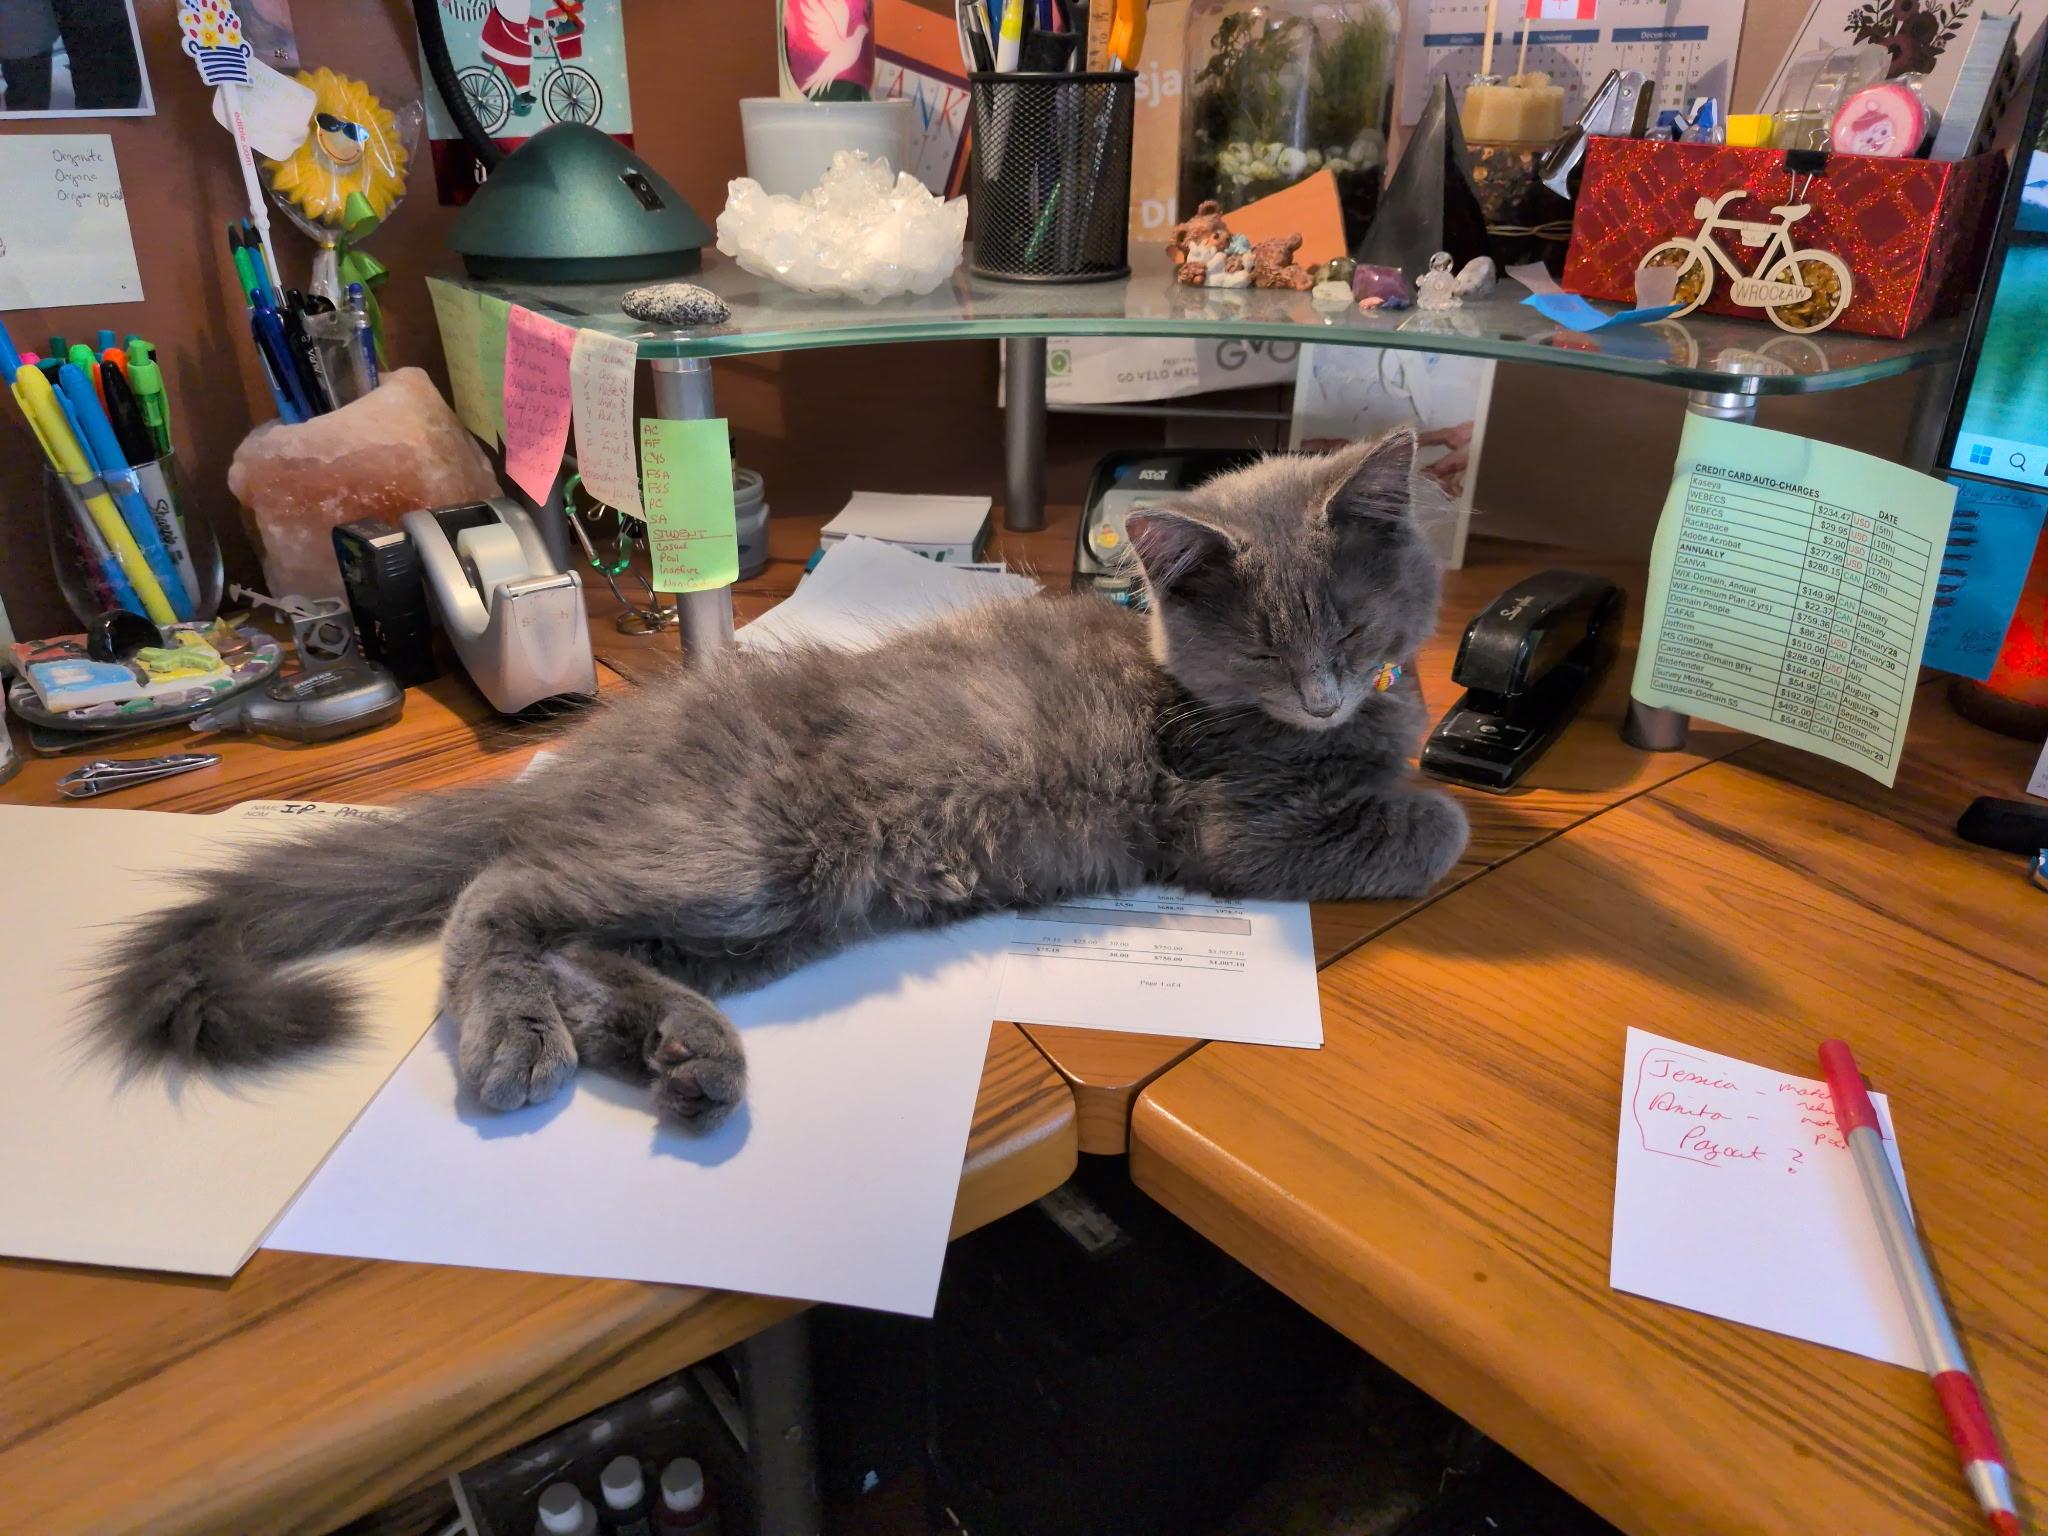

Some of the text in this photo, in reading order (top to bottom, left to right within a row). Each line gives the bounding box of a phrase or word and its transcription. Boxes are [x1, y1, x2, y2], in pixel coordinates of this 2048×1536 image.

[874, 64, 970, 139] ANK
[234, 111, 252, 166] edible.com
[1138, 469, 1169, 481] AT&T
[1695, 463, 1820, 498] CREDIT CARD AUTO-CHARGES
[1687, 503, 1893, 568] WEBECS $2.00 USD (12th)
[1689, 489, 1896, 554] WEBECS $29.95 USD (10th)
[1818, 505, 1851, 521] $234.47
[1853, 516, 1871, 529] USD
[1875, 523, 1894, 538] (5th)
[1878, 510, 1899, 525] DATE
[1680, 543, 1725, 559] ANNUALLY
[1682, 530, 1888, 596] Adobe Acrobat $280.15 CAN (26th)
[1684, 517, 1729, 532] Rackspace
[1845, 558, 1863, 570] USD
[1867, 566, 1891, 582] (17th)
[1677, 557, 1706, 568] CANVA
[1838, 598, 1856, 610] CAN
[1860, 606, 1889, 625] January
[1728, 581, 1757, 595] Annual
[1804, 600, 1833, 616] $22.37
[1835, 611, 1853, 624] CAN
[1858, 619, 1886, 638] January
[1728, 594, 1746, 605] Plan
[1833, 624, 1851, 637] CAN
[1669, 593, 1701, 607] Domain
[1703, 601, 1731, 615] People
[1830, 637, 1848, 649] USD
[1676, 633, 1714, 649] OneDrive
[1822, 675, 1840, 688] CAN
[1845, 683, 1871, 701] August
[1825, 662, 1843, 674] USD
[1848, 671, 1862, 683] July
[1828, 649, 1846, 662] CAN
[1850, 659, 1868, 672] April
[1654, 667, 1681, 680] Survey
[1683, 673, 1714, 688] Monkey
[1814, 712, 1833, 724] CAN
[1837, 721, 1868, 740] October
[1817, 700, 1835, 712] CAN
[1840, 708, 1880, 732] September
[1820, 687, 1838, 699] CAN
[1811, 725, 1830, 737] CAN
